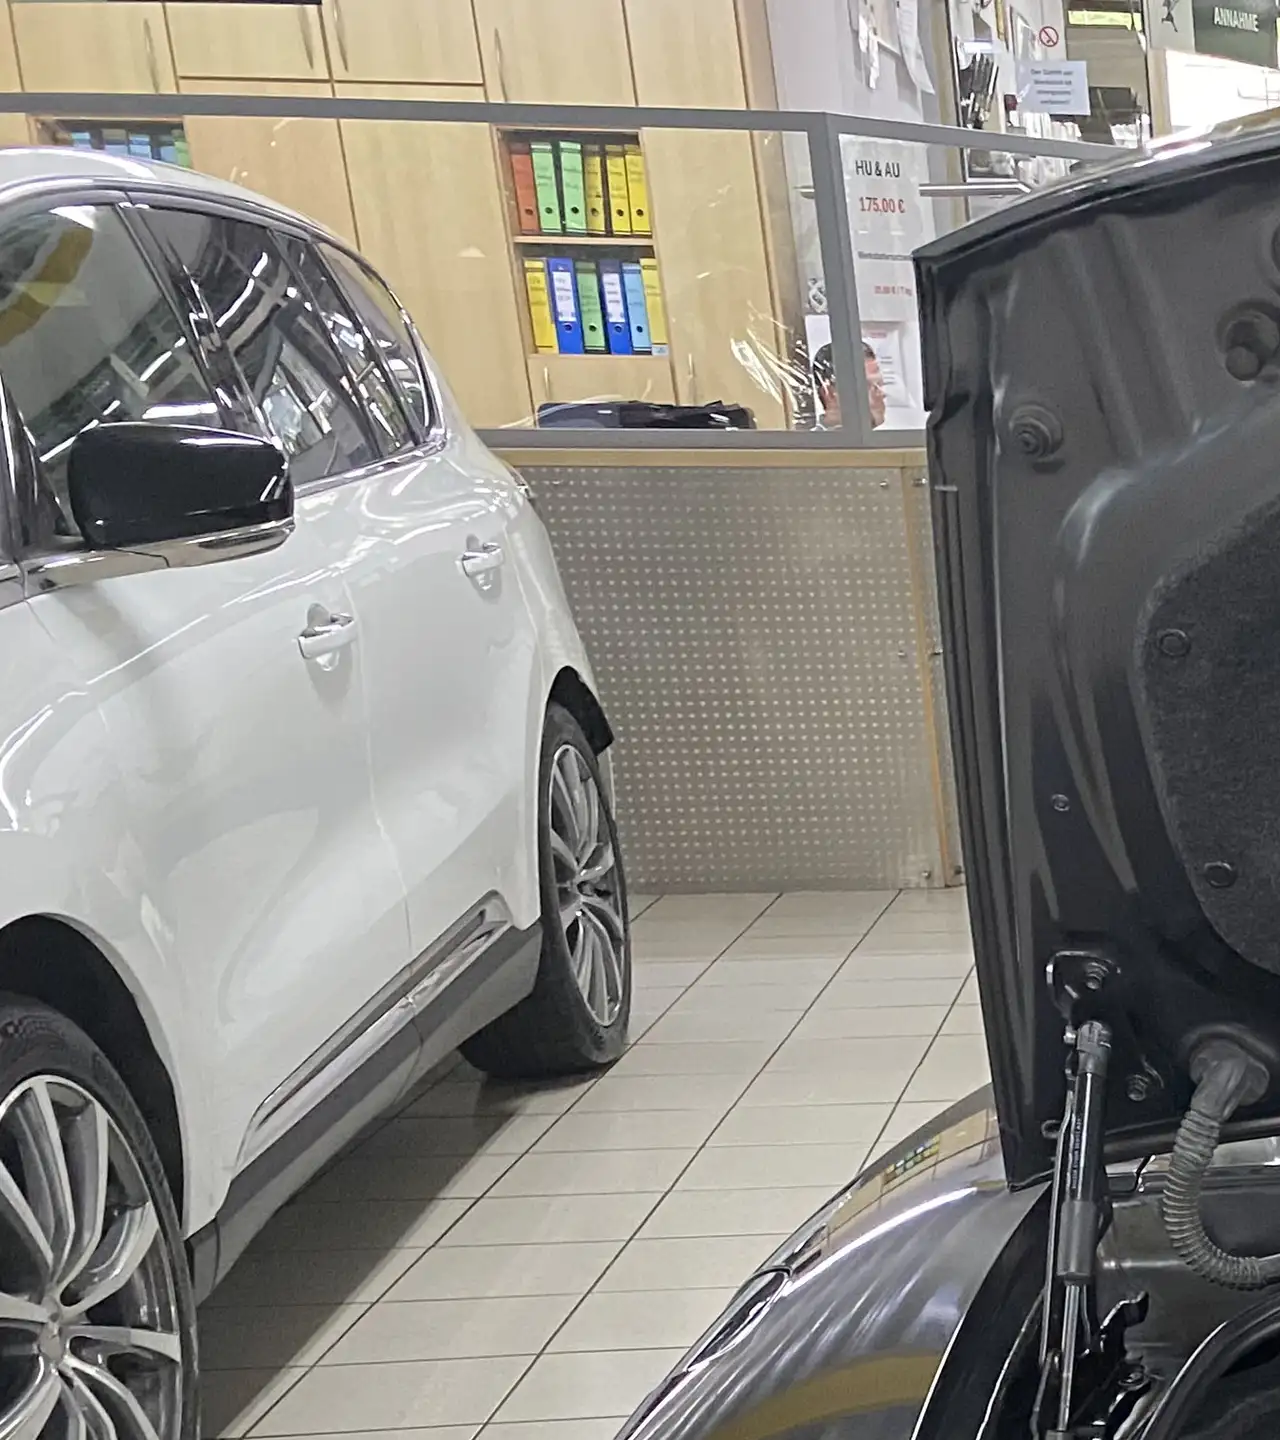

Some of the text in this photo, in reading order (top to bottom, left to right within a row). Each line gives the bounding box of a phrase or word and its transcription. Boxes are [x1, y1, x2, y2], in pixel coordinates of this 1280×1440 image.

[1214, 6, 1260, 33] ANNAHME
[855, 160, 901, 178] HU & AU
